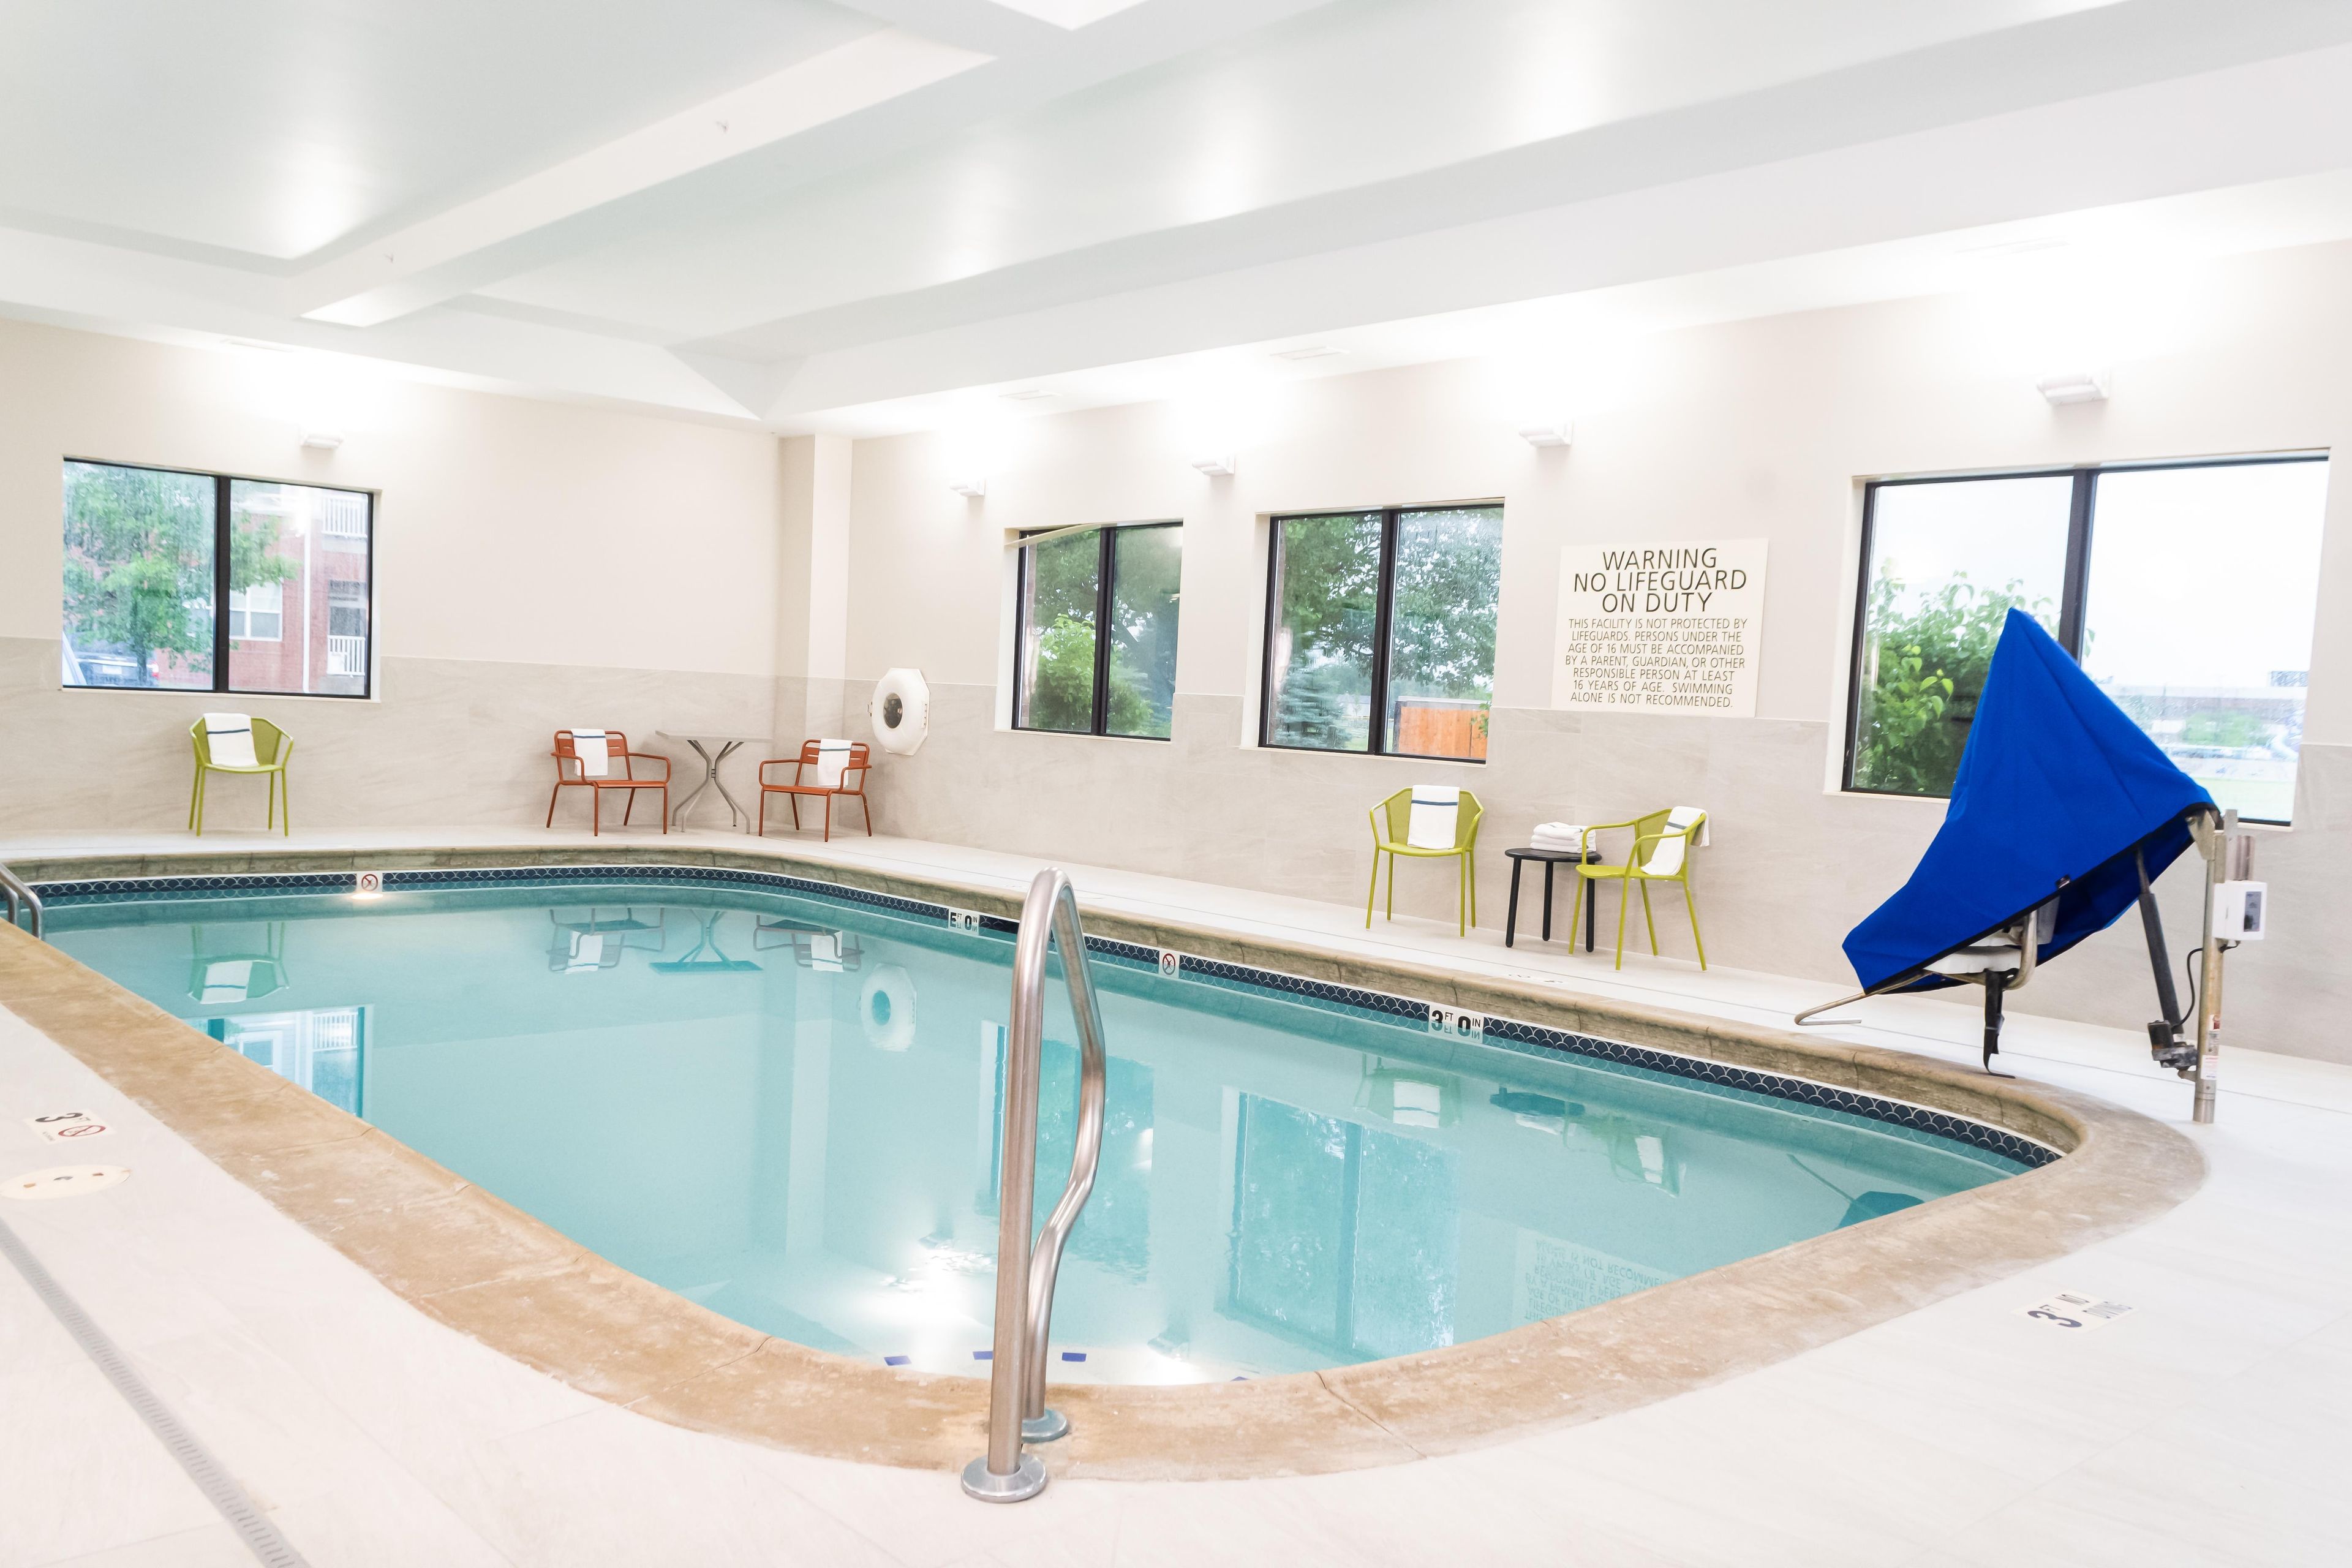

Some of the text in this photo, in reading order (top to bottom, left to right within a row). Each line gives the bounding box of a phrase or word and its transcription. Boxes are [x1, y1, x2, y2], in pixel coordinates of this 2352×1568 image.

[1603, 548, 1716, 570] WARNING
[1574, 570, 1746, 592] NO LIFEGUARD
[1602, 592, 1712, 612] ON DUTY
[1569, 619, 1747, 629] THIS FACILITY IS NOT PROTECTED BY
[1572, 631, 1741, 642] LIFEGUARDS. PERSONS UNDER THE
[1568, 644, 1744, 655] AGE OF 16 MUST BE ACCOMPANIED
[1566, 656, 1744, 669] BY A PARENT, GUARDIAN, OR OTHER
[1574, 668, 1735, 681] RESPONSIBLE PERSON AT LEAST
[1574, 680, 1732, 695] 16 YEARS OF AGE. SWIMMING
[1570, 693, 1733, 707] ALONE IS NOT RECOMMENDED.
[1445, 1012, 1453, 1021] FT
[1472, 1018, 1480, 1028] IN
[35, 1113, 83, 1122] 3
[2027, 1311, 2082, 1328] 3
